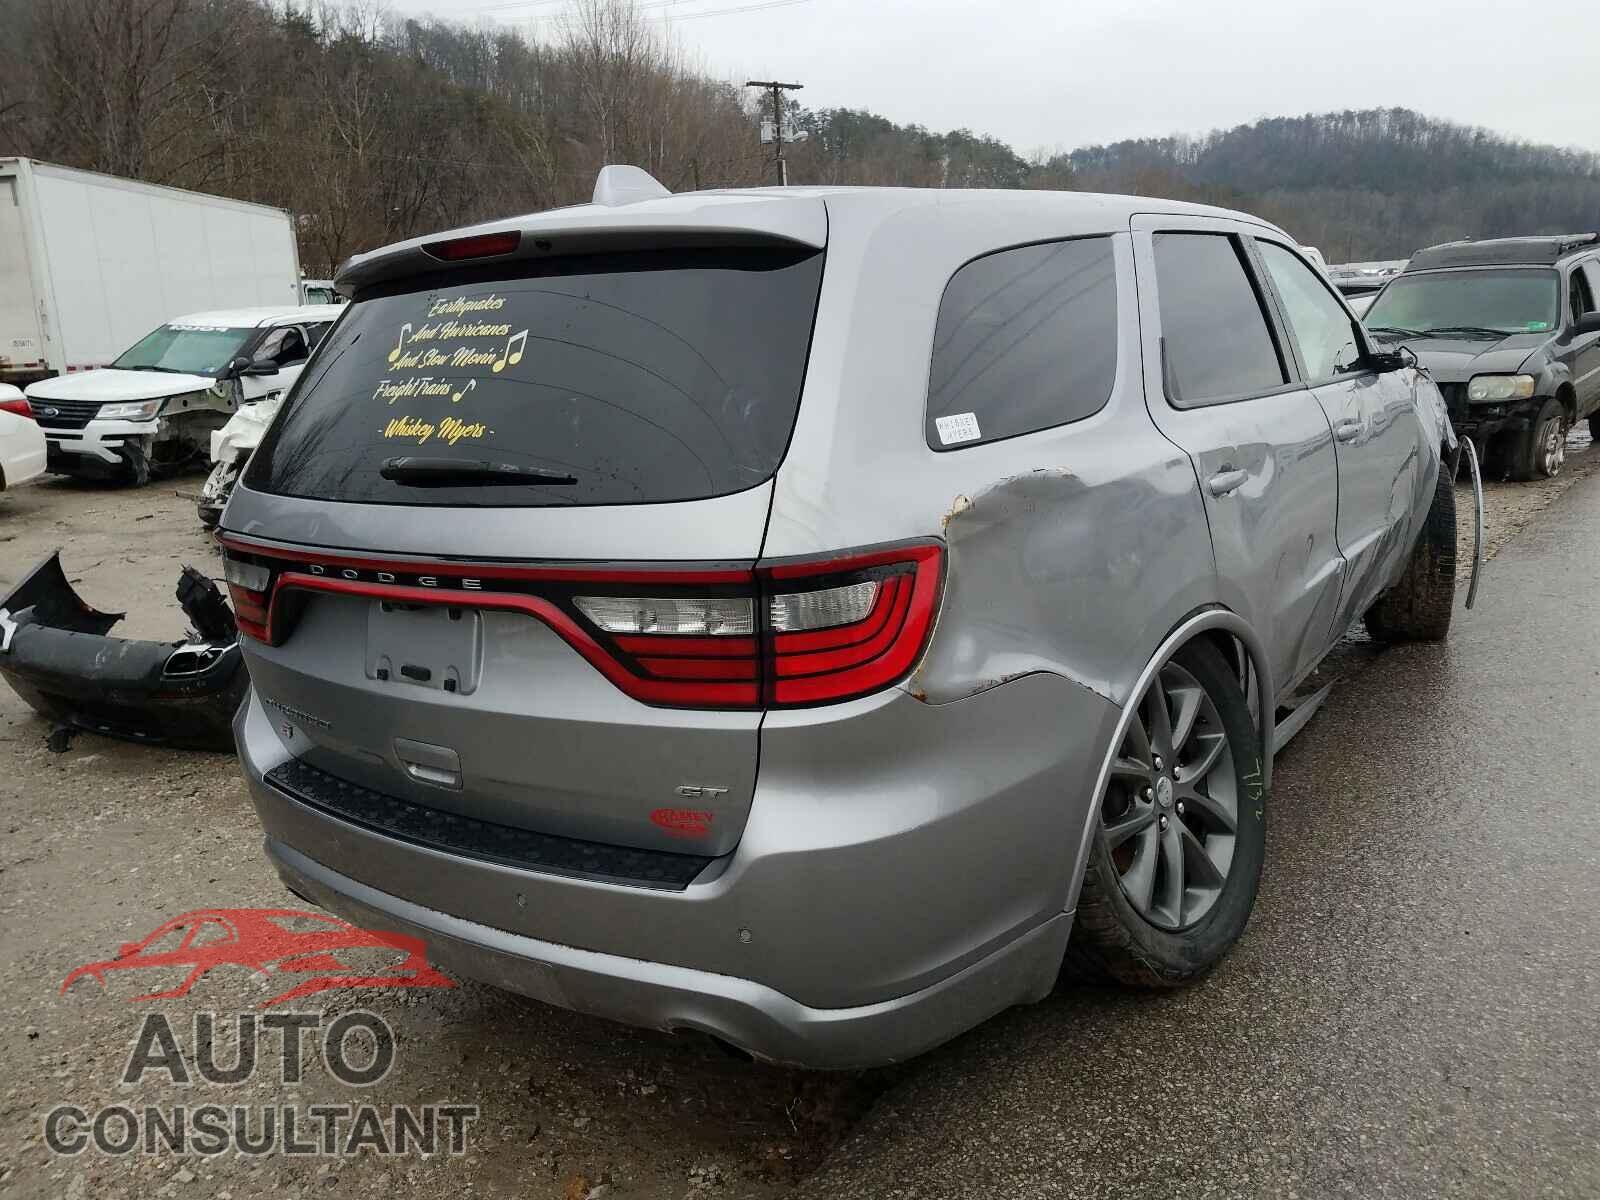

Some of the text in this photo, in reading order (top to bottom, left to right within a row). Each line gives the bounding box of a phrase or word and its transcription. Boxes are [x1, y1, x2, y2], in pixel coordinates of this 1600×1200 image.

[428, 294, 507, 318] Earthquakes
[407, 320, 512, 344] And Hurricanes
[389, 351, 421, 371] And
[418, 349, 449, 368] Slow
[373, 377, 453, 405] Freight Trains
[384, 415, 486, 446] Whiskey Myers
[310, 565, 482, 589] DODGE
